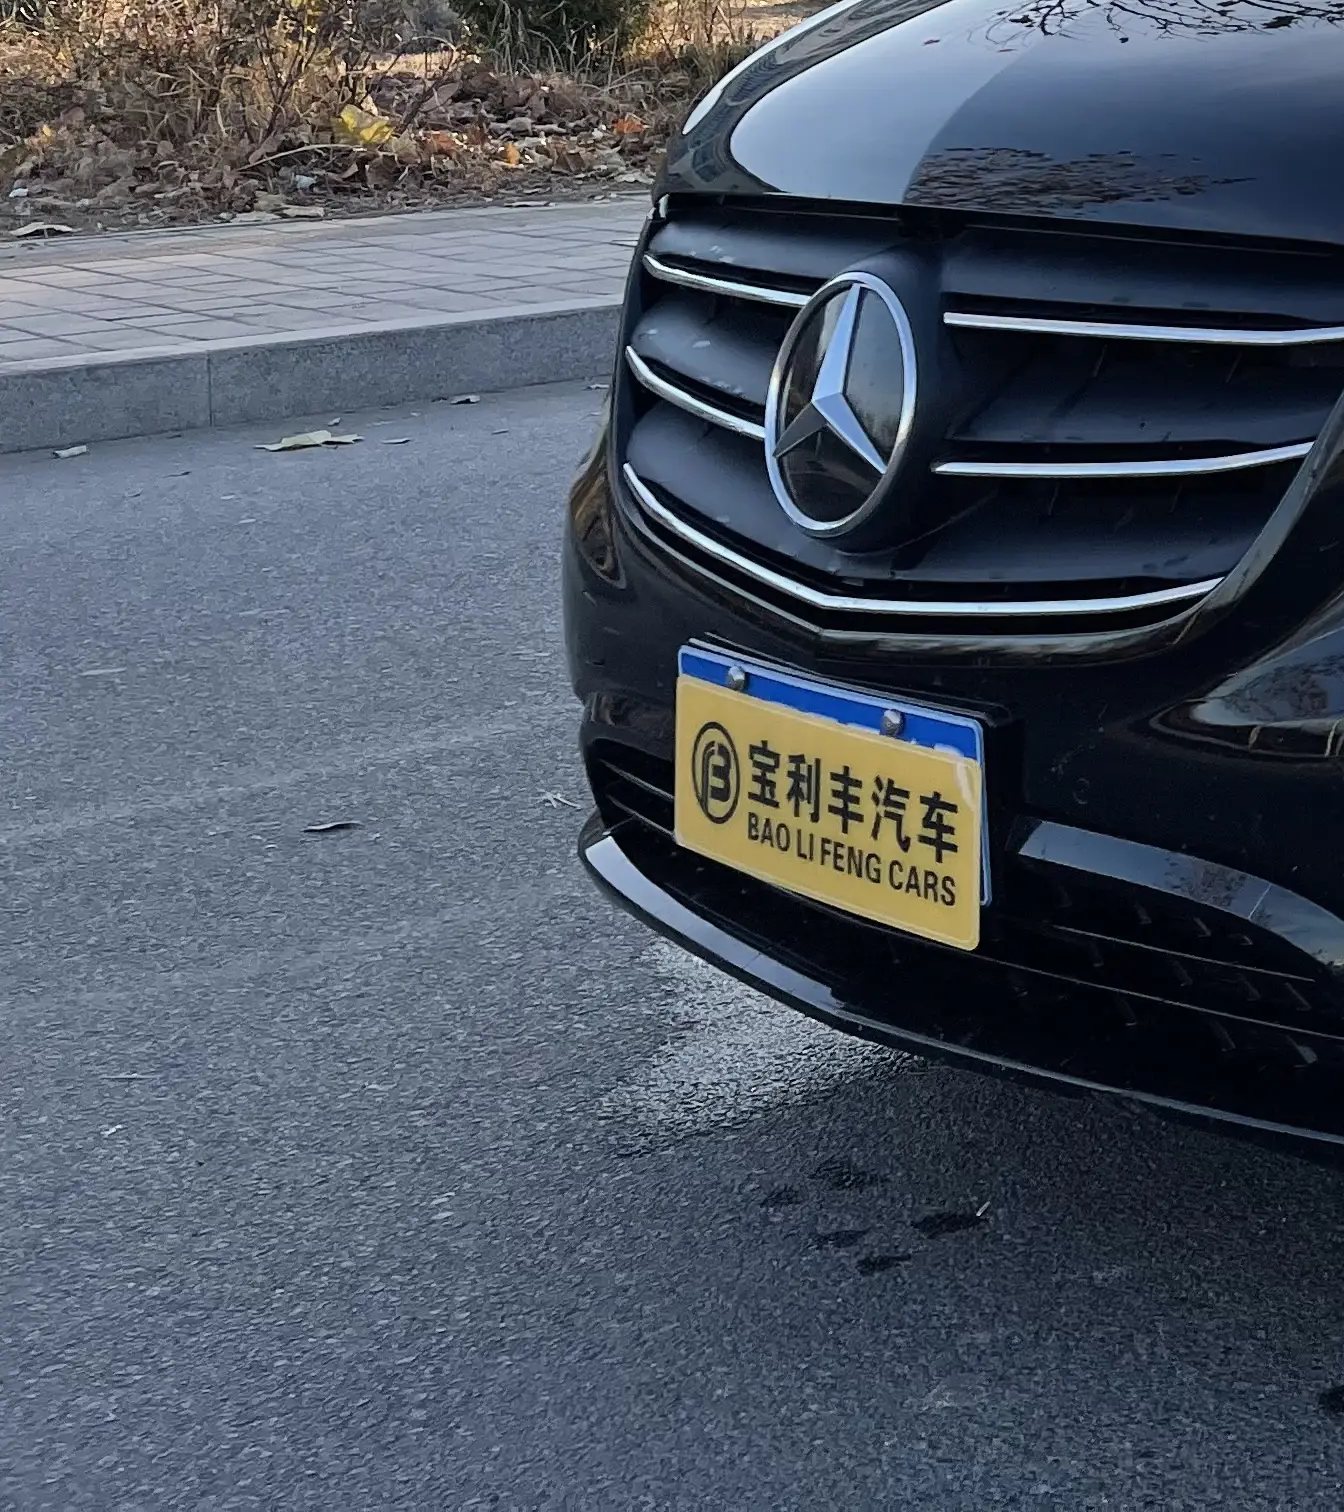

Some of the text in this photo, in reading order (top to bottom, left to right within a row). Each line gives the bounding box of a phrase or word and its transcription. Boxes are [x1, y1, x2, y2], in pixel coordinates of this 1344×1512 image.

[747, 740, 958, 863] 宝利丰汽车
[747, 811, 957, 907] BAO LI FENG CARS
